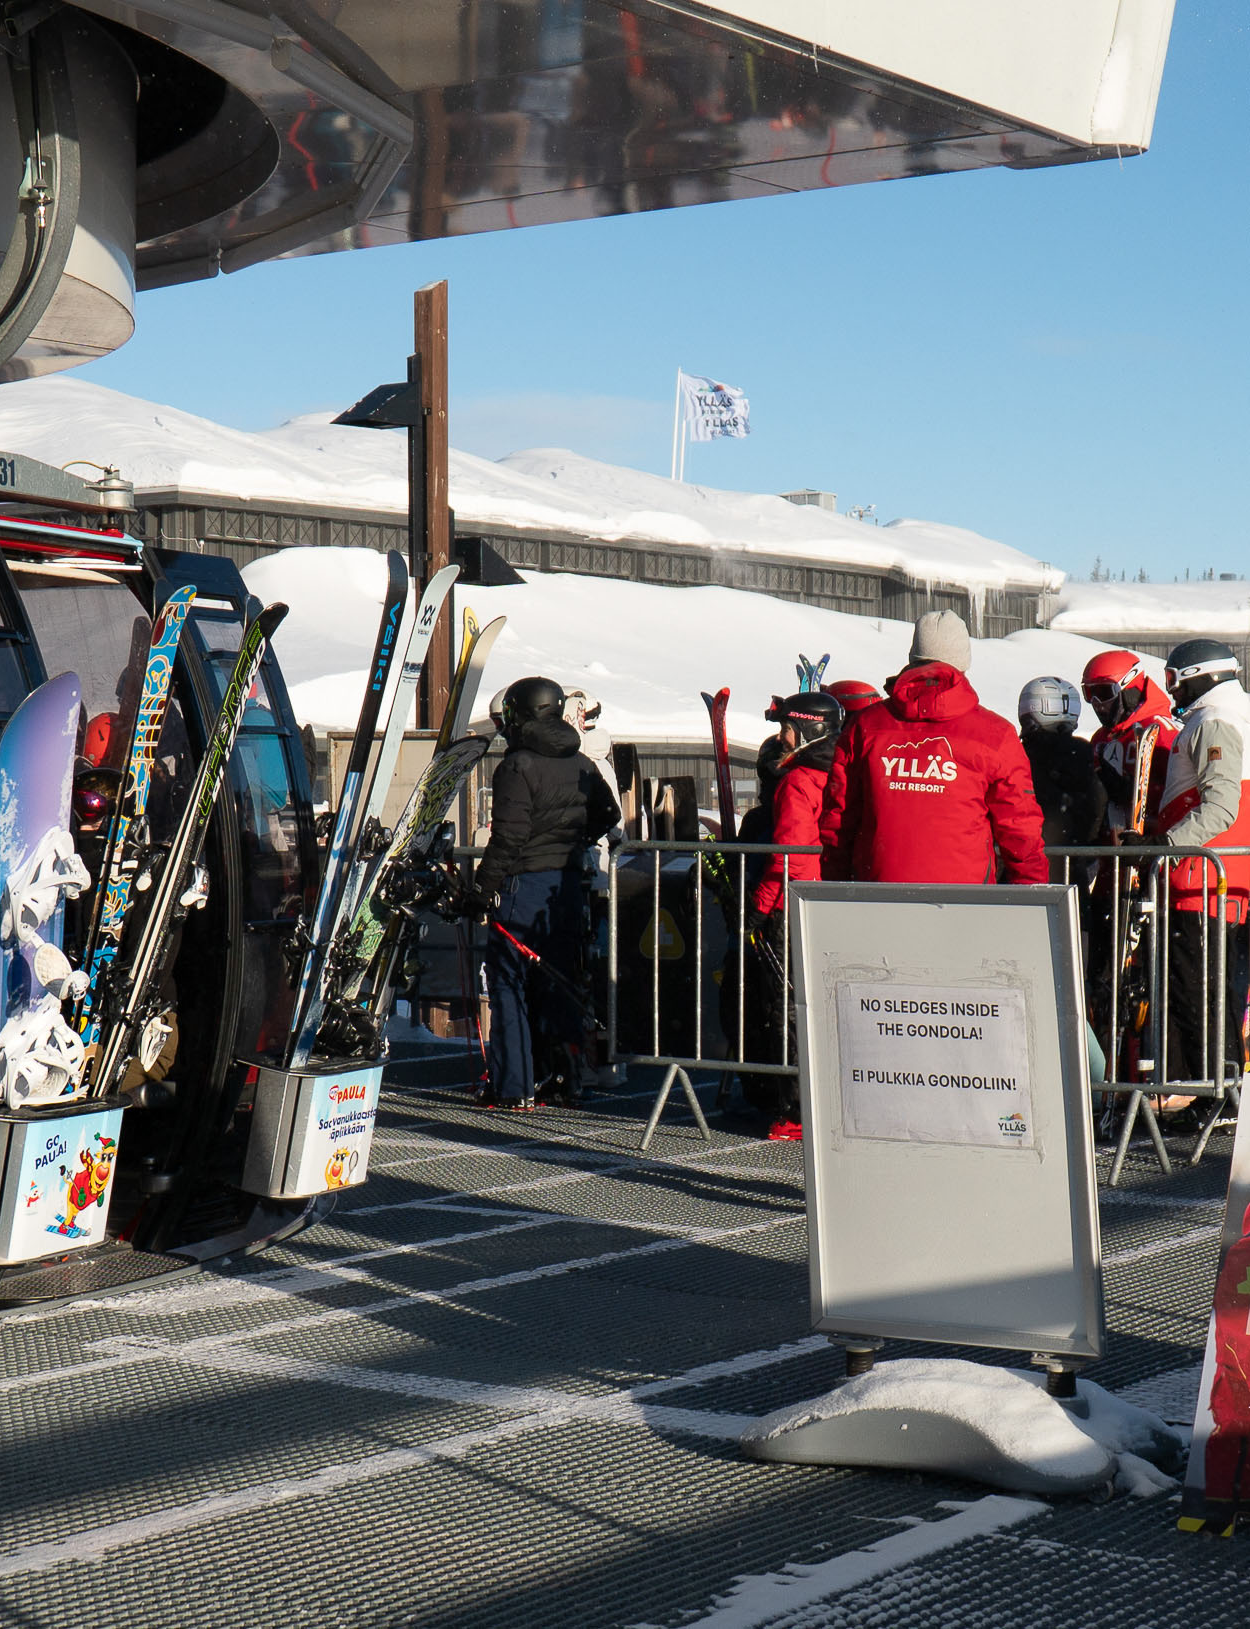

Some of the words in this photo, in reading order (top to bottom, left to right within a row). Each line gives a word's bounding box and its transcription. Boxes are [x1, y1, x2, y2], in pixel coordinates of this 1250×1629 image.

[695, 394, 733, 408] YLLÄS
[881, 754, 958, 782] YLLÄS
[889, 782, 906, 790] SKI
[908, 783, 945, 793] RESORT
[860, 998, 881, 1012] NO
[884, 1000, 948, 1015] SLEDGES
[951, 1002, 999, 1017] INSIDE
[877, 1022, 903, 1036] THE
[907, 1024, 983, 1040] GONDOLA!
[852, 1070, 864, 1082] EI
[868, 1071, 925, 1086] PULKKIA
[928, 1075, 1017, 1091] GONDOLIIN!
[337, 1085, 366, 1104] PAULA
[998, 1121, 1026, 1132] YLLÄS
[46, 1134, 60, 1150] GO
